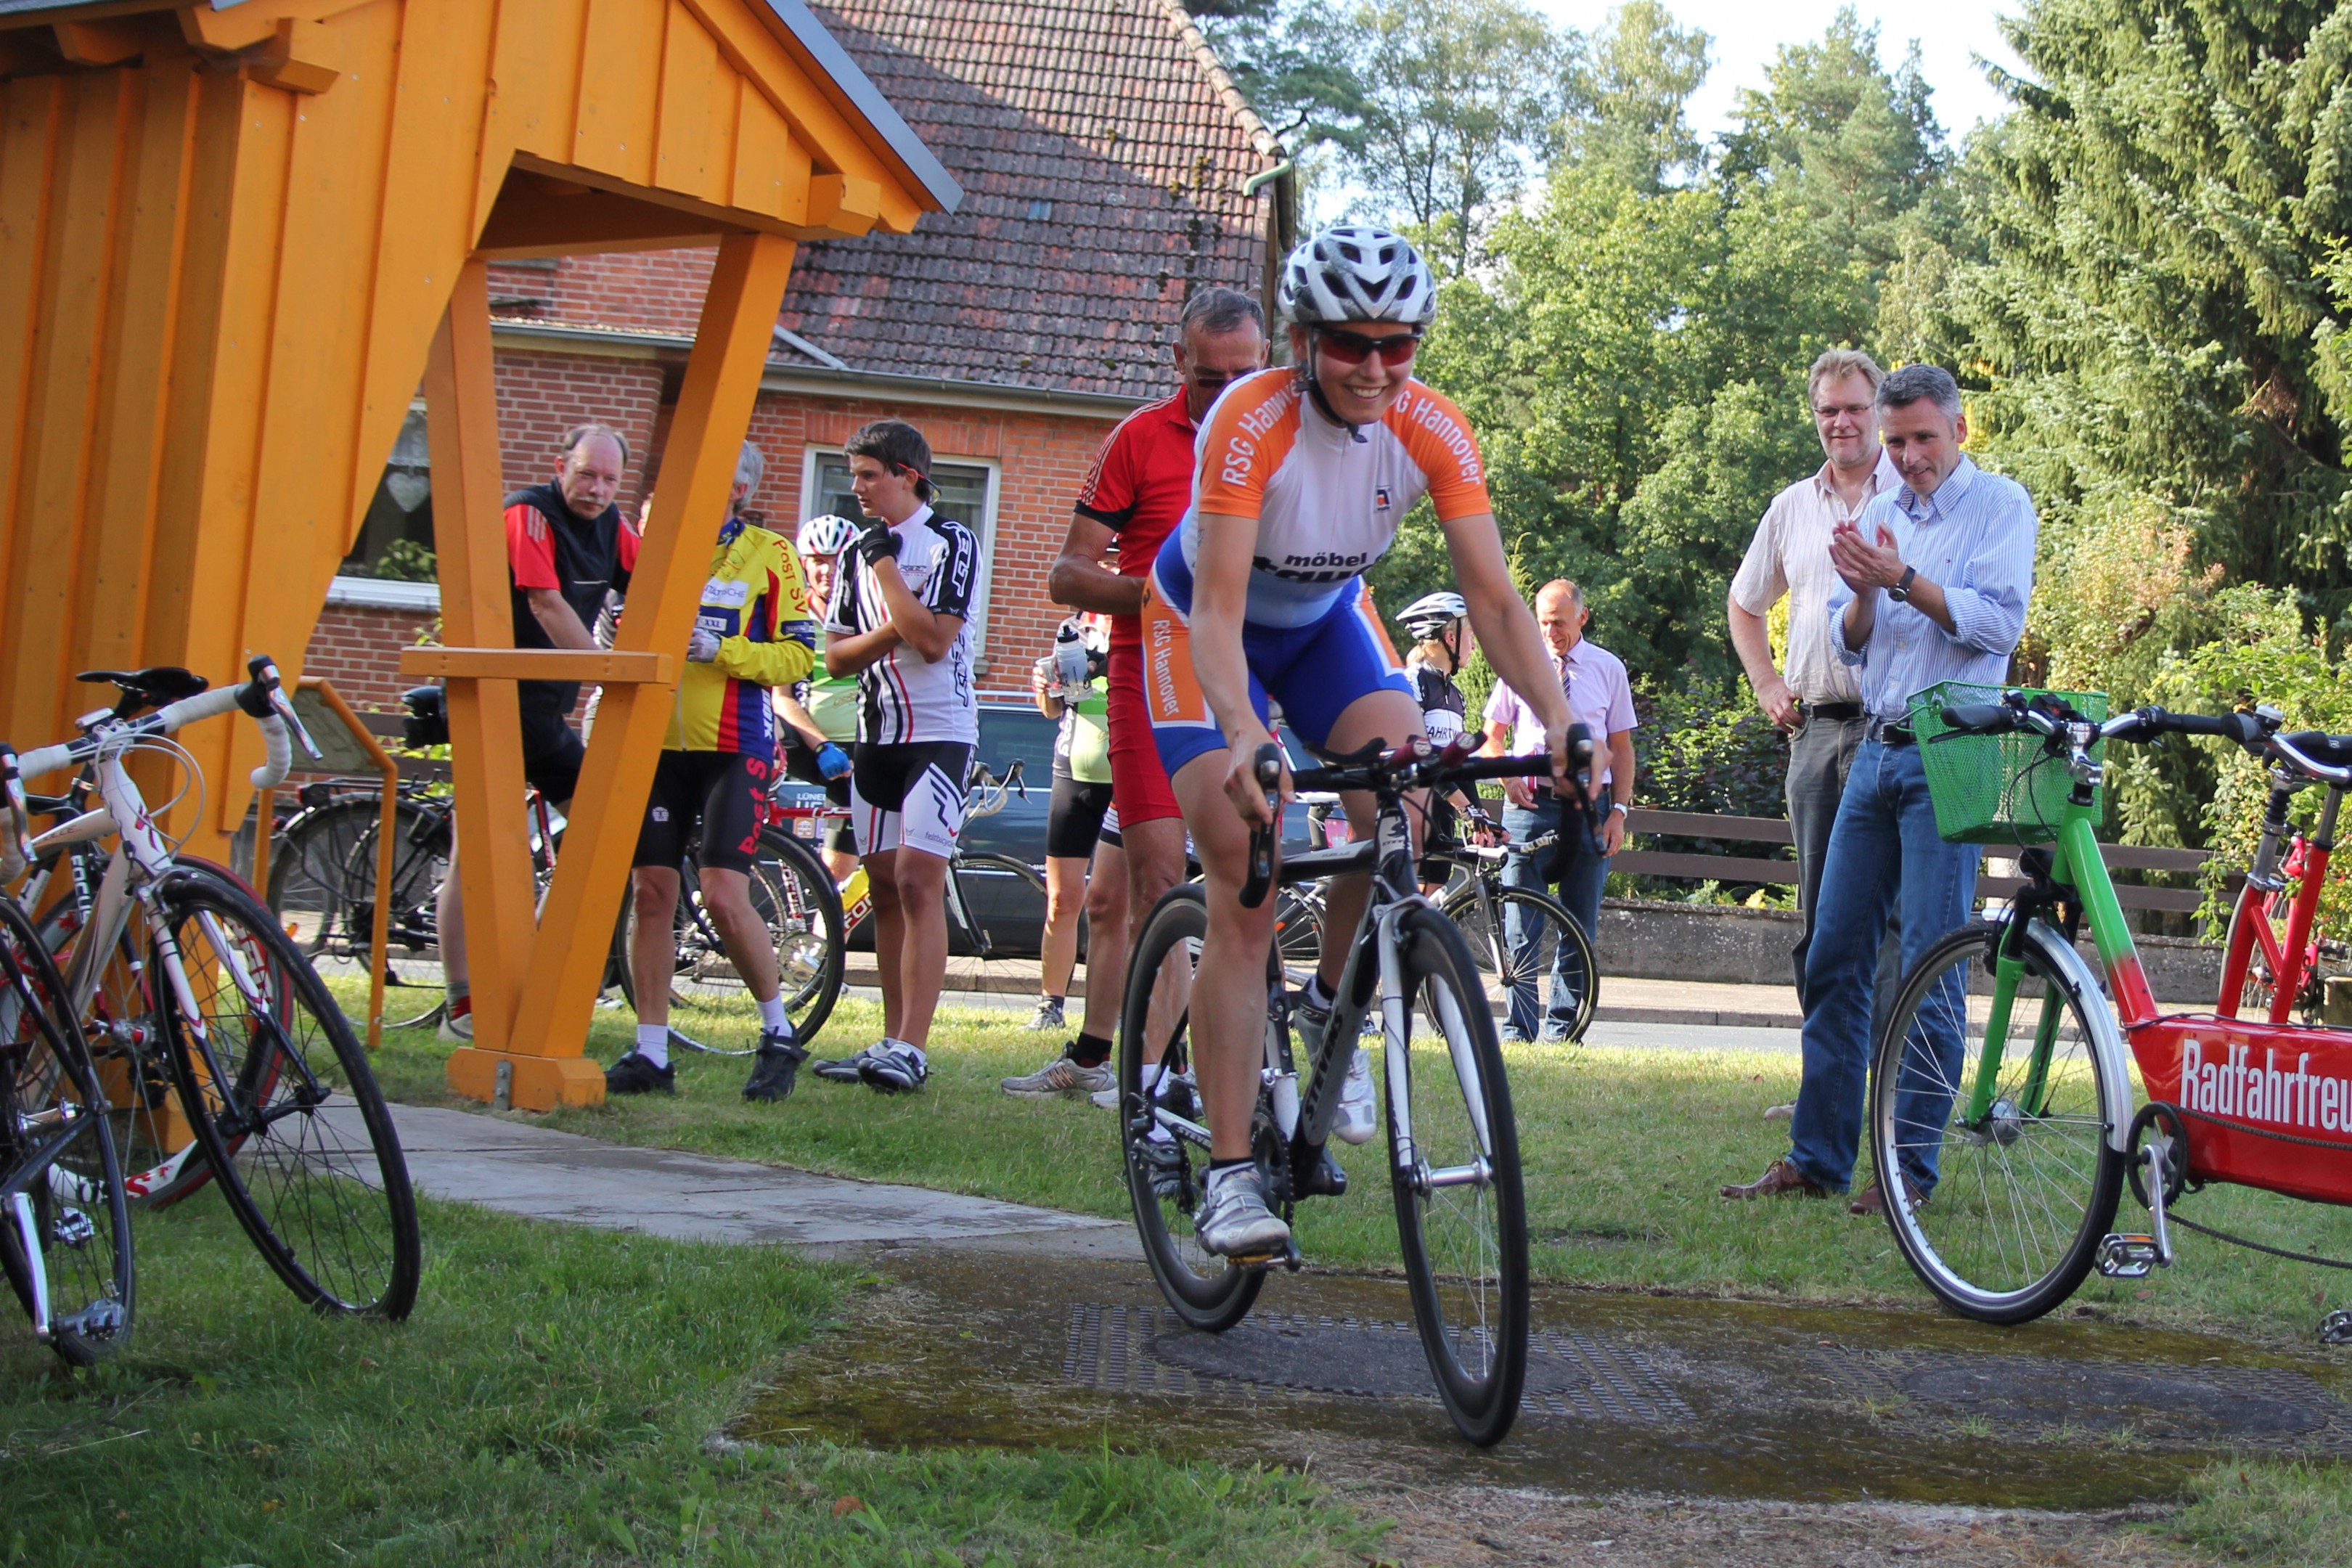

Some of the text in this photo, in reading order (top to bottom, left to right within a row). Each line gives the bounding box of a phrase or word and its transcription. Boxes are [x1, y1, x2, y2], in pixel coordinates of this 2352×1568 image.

[1221, 436, 1255, 487] RSG
[1411, 397, 1481, 486] Hannover
[772, 539, 796, 581] POST
[1284, 552, 1368, 568] möbel
[1153, 619, 1179, 716] RSG Hannover
[1304, 1013, 1343, 1122] STEVENS
